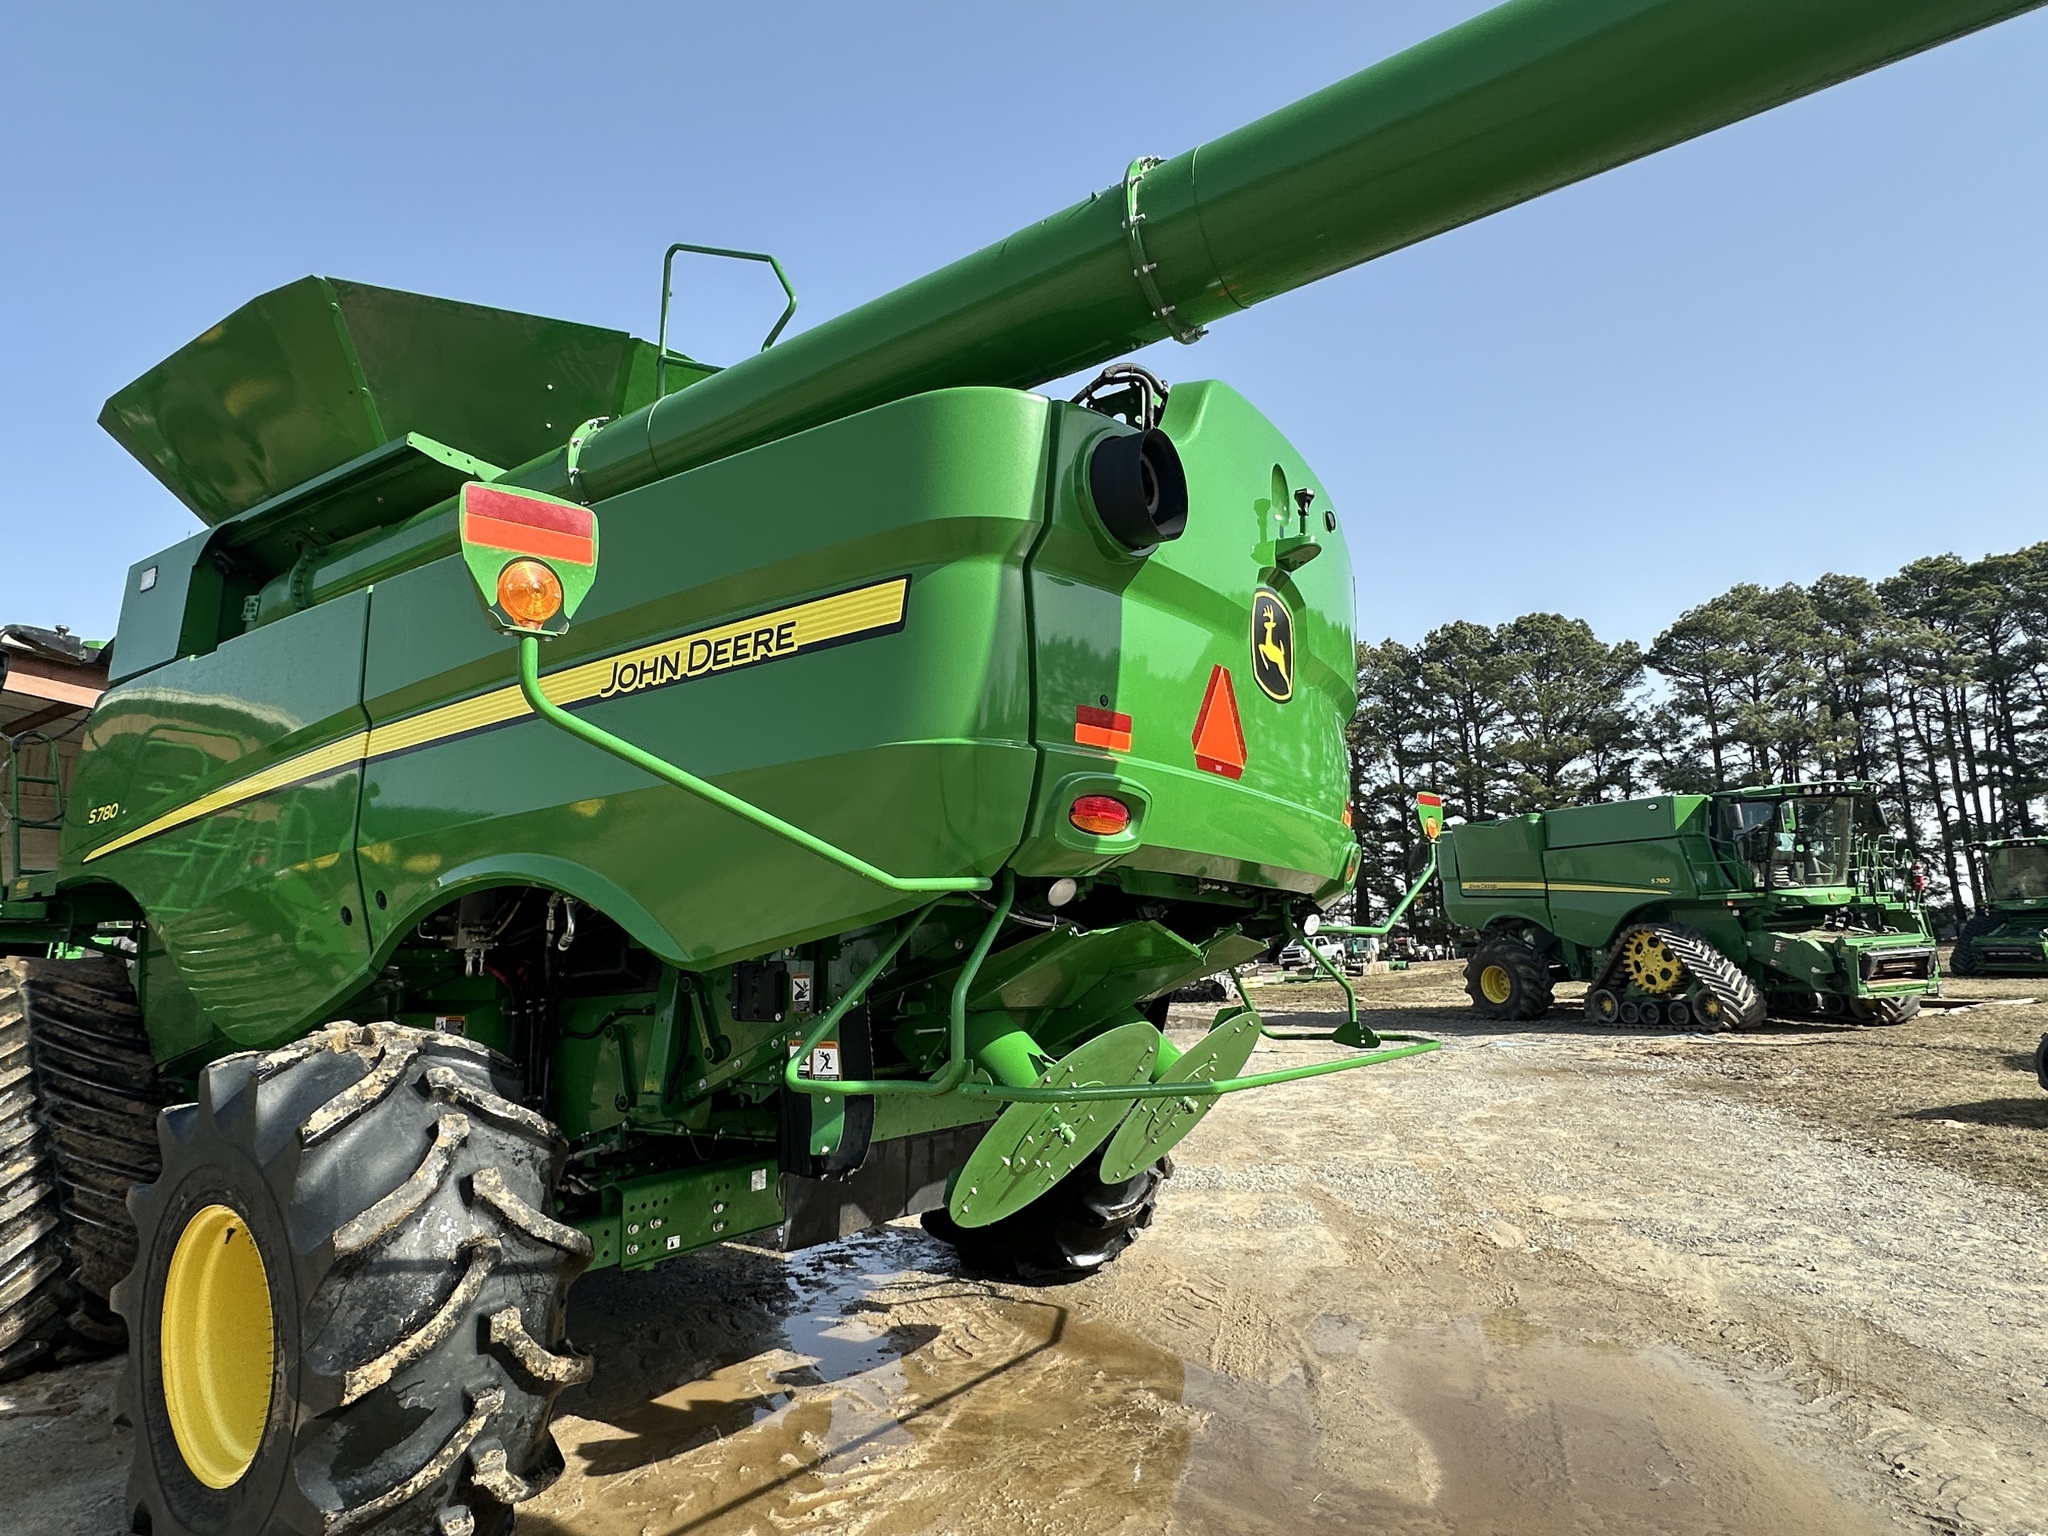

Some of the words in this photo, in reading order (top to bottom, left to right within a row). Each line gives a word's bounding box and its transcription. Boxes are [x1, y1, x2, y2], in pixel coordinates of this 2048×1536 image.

[601, 650, 681, 694] JOHN
[687, 620, 797, 673] DEERE
[88, 802, 119, 824] S780
